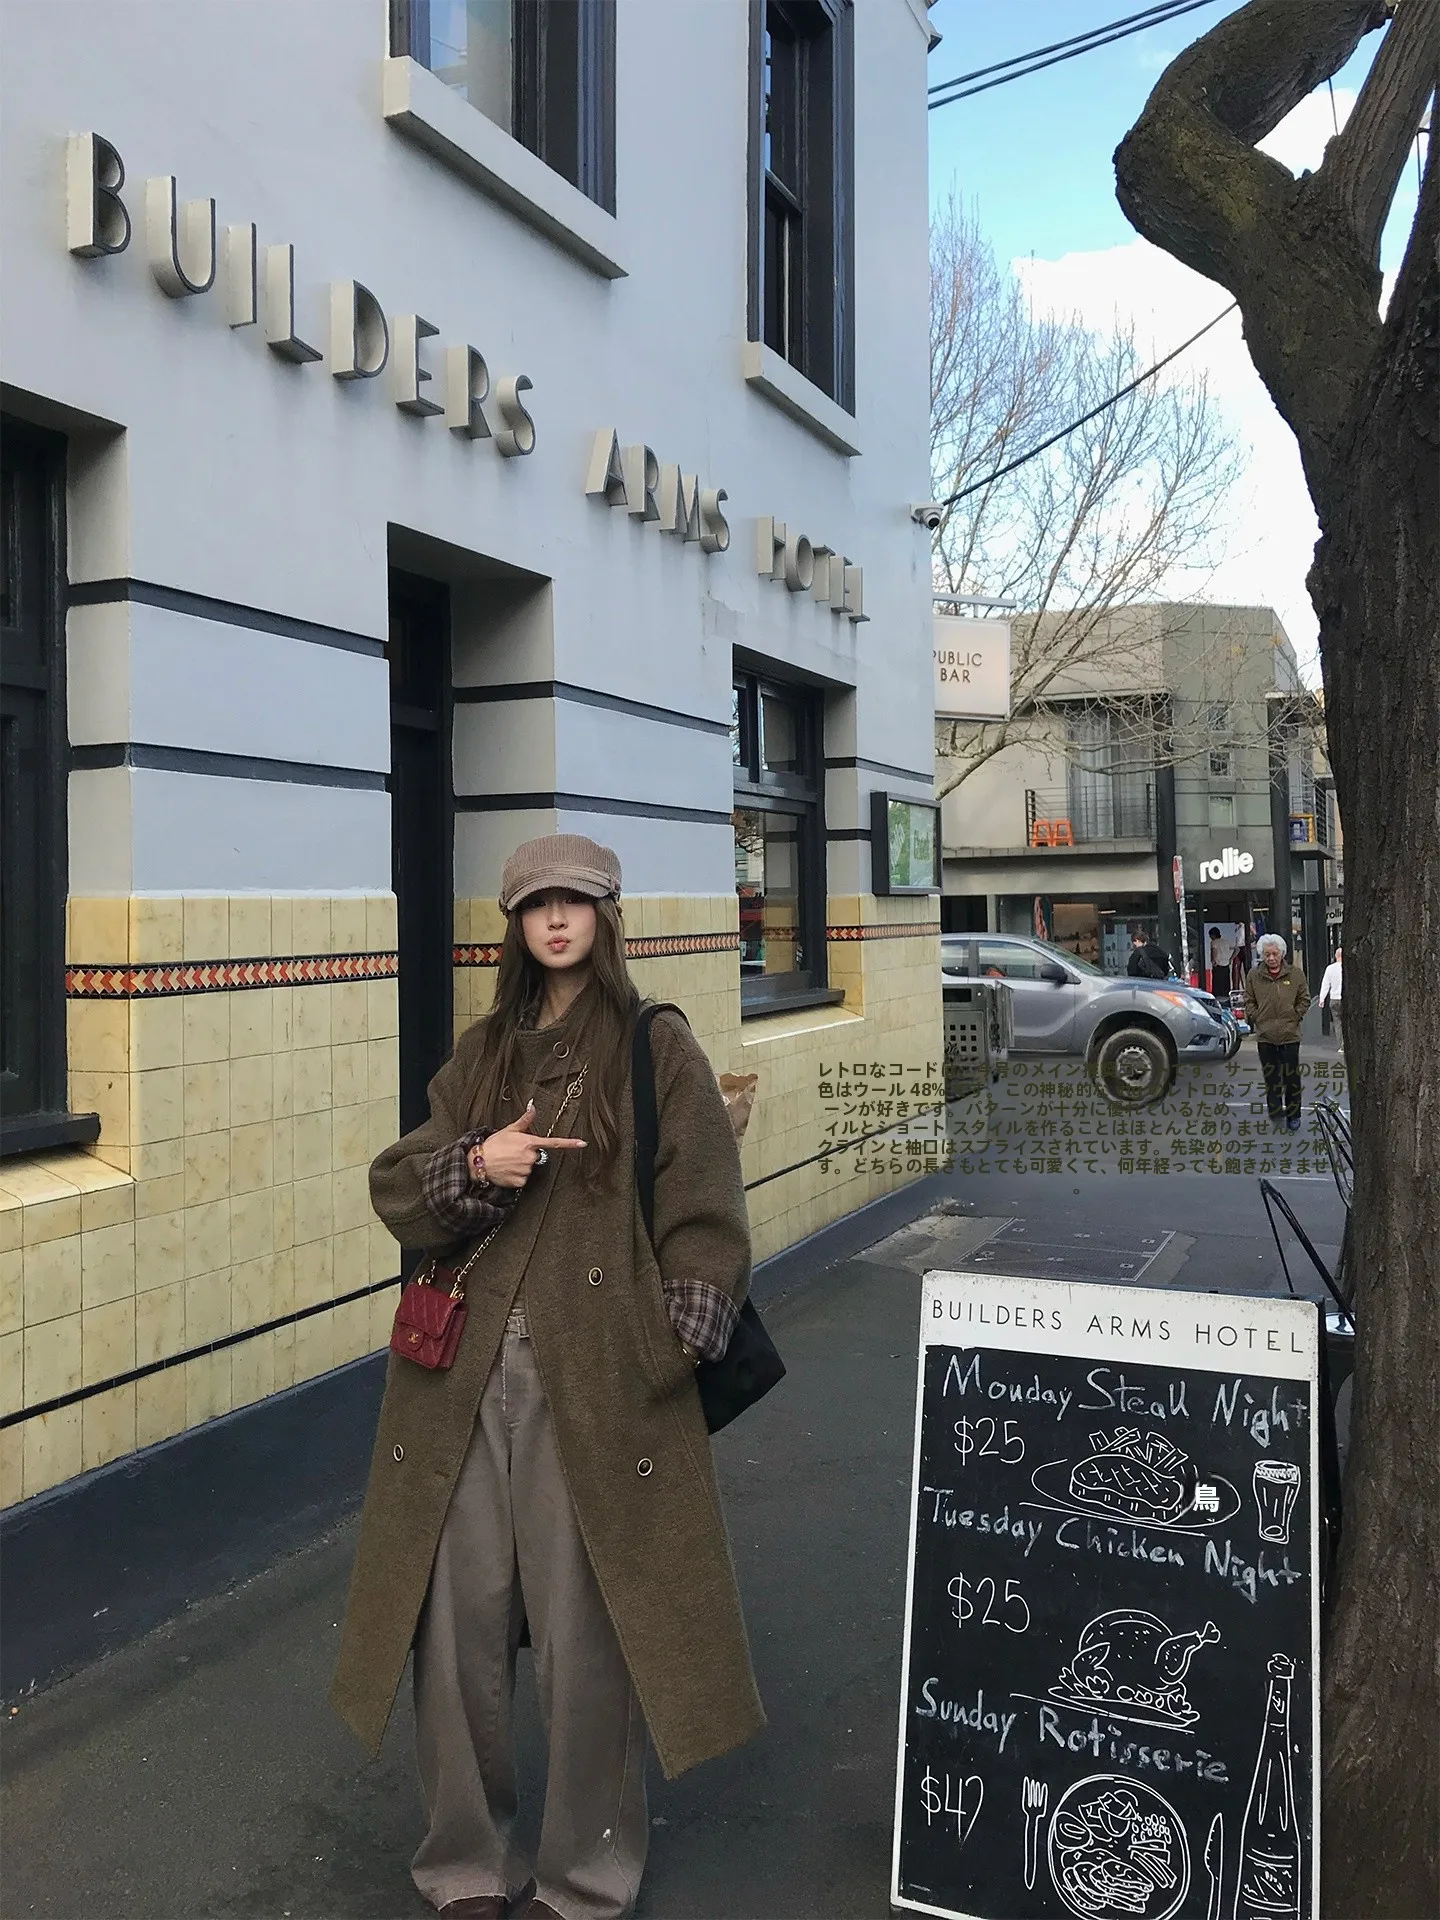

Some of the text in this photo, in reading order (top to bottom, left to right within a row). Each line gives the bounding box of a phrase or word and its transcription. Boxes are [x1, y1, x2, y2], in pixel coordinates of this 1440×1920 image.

[66, 131, 871, 623] BUILDERS ARMS HOTEL
[940, 667, 971, 684] BAR
[1199, 846, 1255, 883] rollie
[1325, 908, 1344, 920] rolli
[931, 1298, 1305, 1354] BUILDERS ARMS HOTEL
[941, 1353, 1073, 1421] Monday
[1211, 1378, 1309, 1448] Night
[953, 1415, 1027, 1467] $25
[923, 1485, 1303, 1605] Tuesday Chicken Night
[946, 1571, 1032, 1633] $25
[915, 1677, 1230, 1783] Sunday Rotisserie
